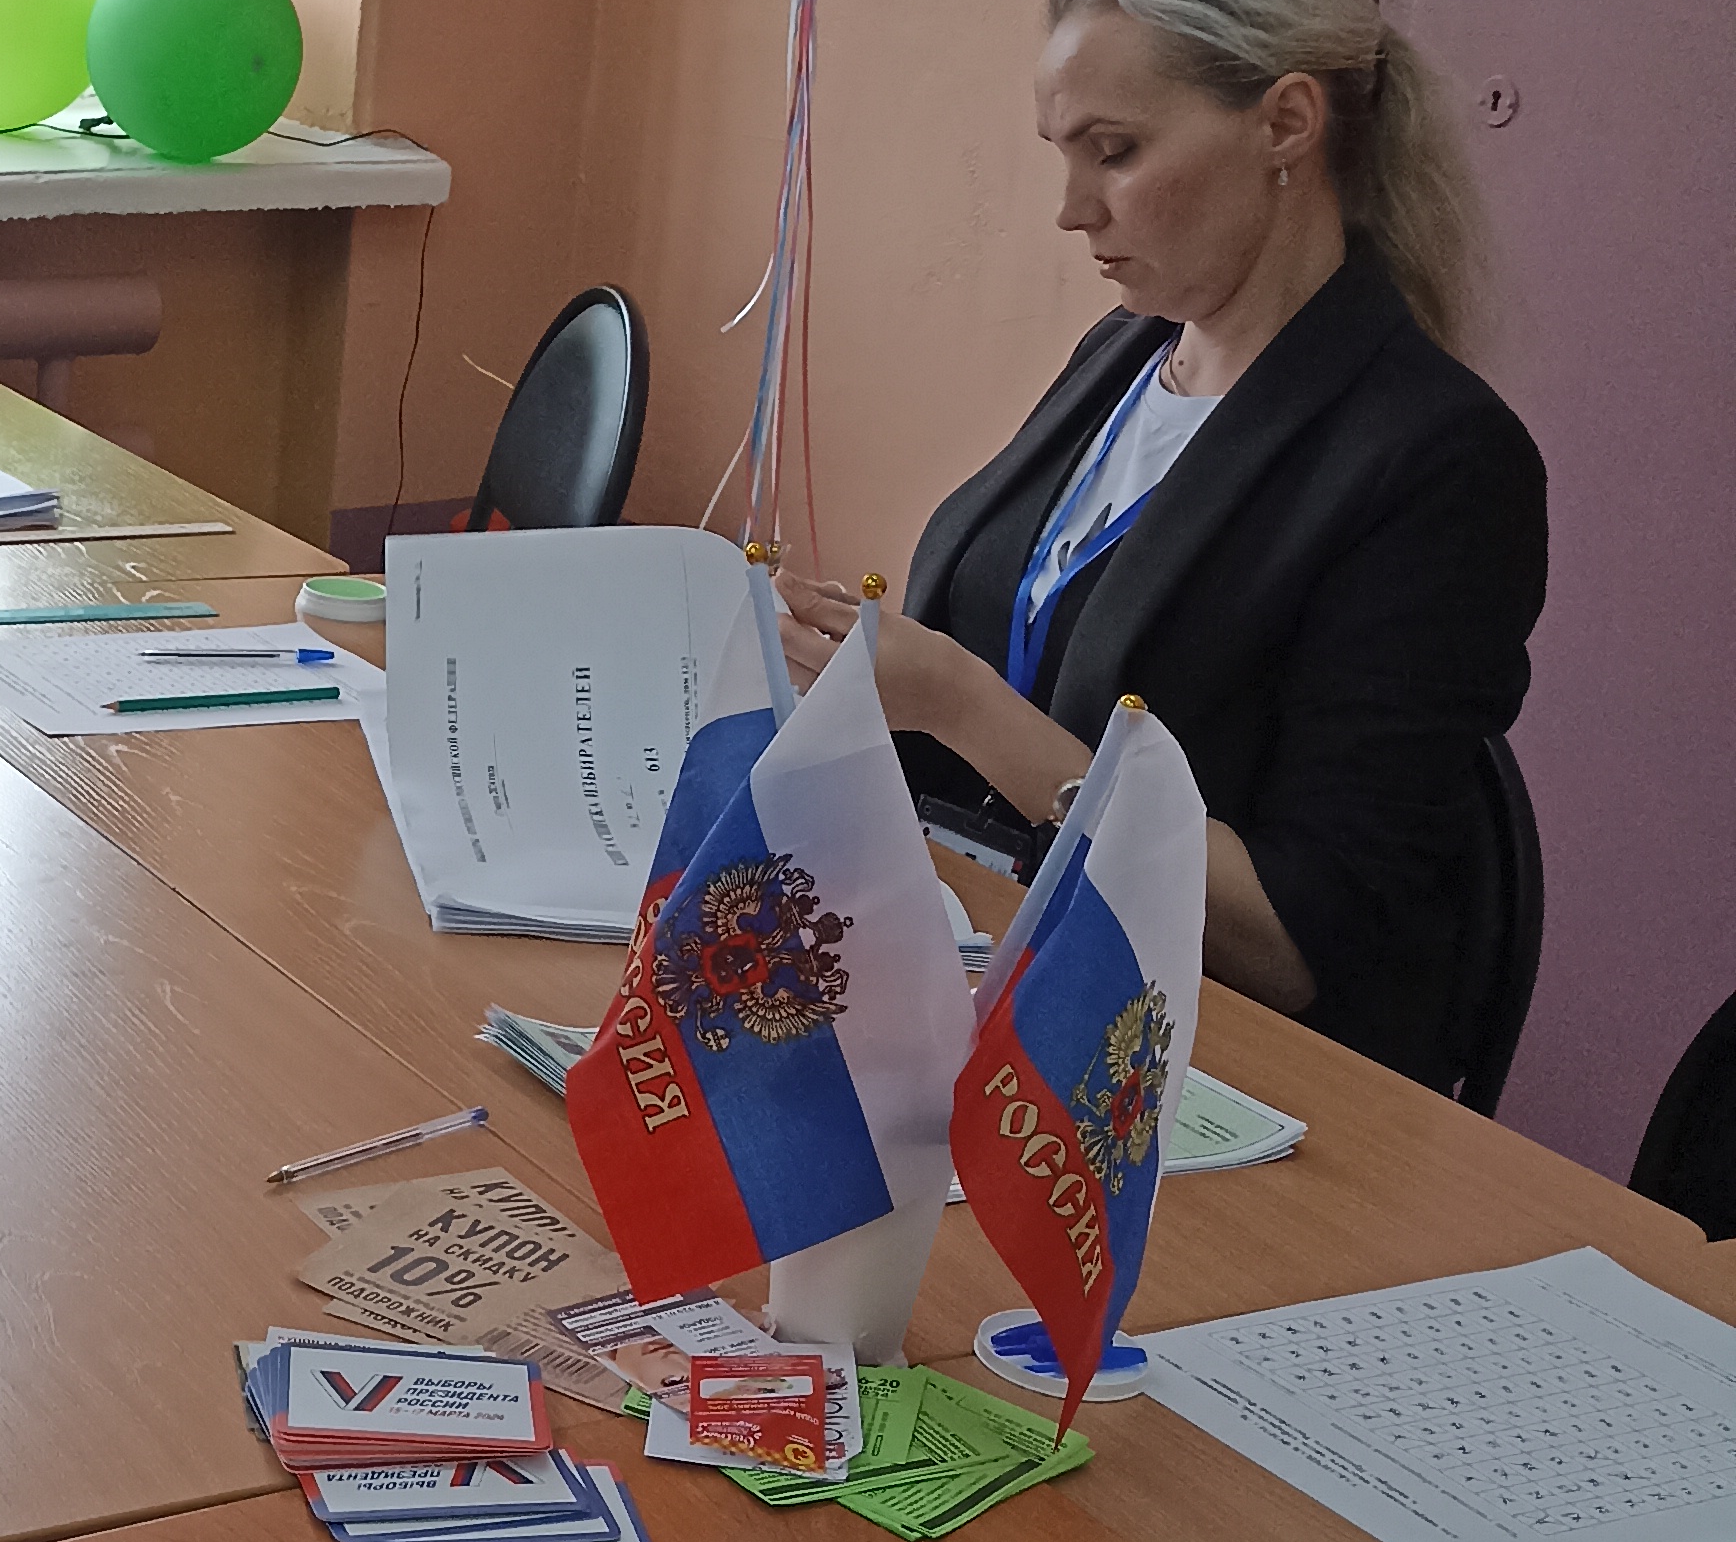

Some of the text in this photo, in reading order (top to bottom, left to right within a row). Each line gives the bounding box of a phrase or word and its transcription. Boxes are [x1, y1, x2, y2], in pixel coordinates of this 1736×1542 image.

[572, 666, 599, 798] ИЗБИРАТЕЛЕЙ
[643, 747, 660, 772] 613
[984, 1063, 1103, 1299] РОССИЯ
[408, 1228, 538, 1283] НА СКИДКУ
[428, 1208, 570, 1273] КУПОН
[366, 1245, 501, 1309] 10%
[327, 1275, 455, 1333] ПОДОРОЖНИК
[396, 1397, 470, 1410] РОССИИ
[404, 1387, 520, 1403] ПРЕЗИДЕНТА
[412, 1377, 495, 1391] ВЫБОРЫ
[326, 1468, 441, 1482] ПРЕЗИДЕНТА
[357, 1479, 437, 1491] ВЫБОРЫ
